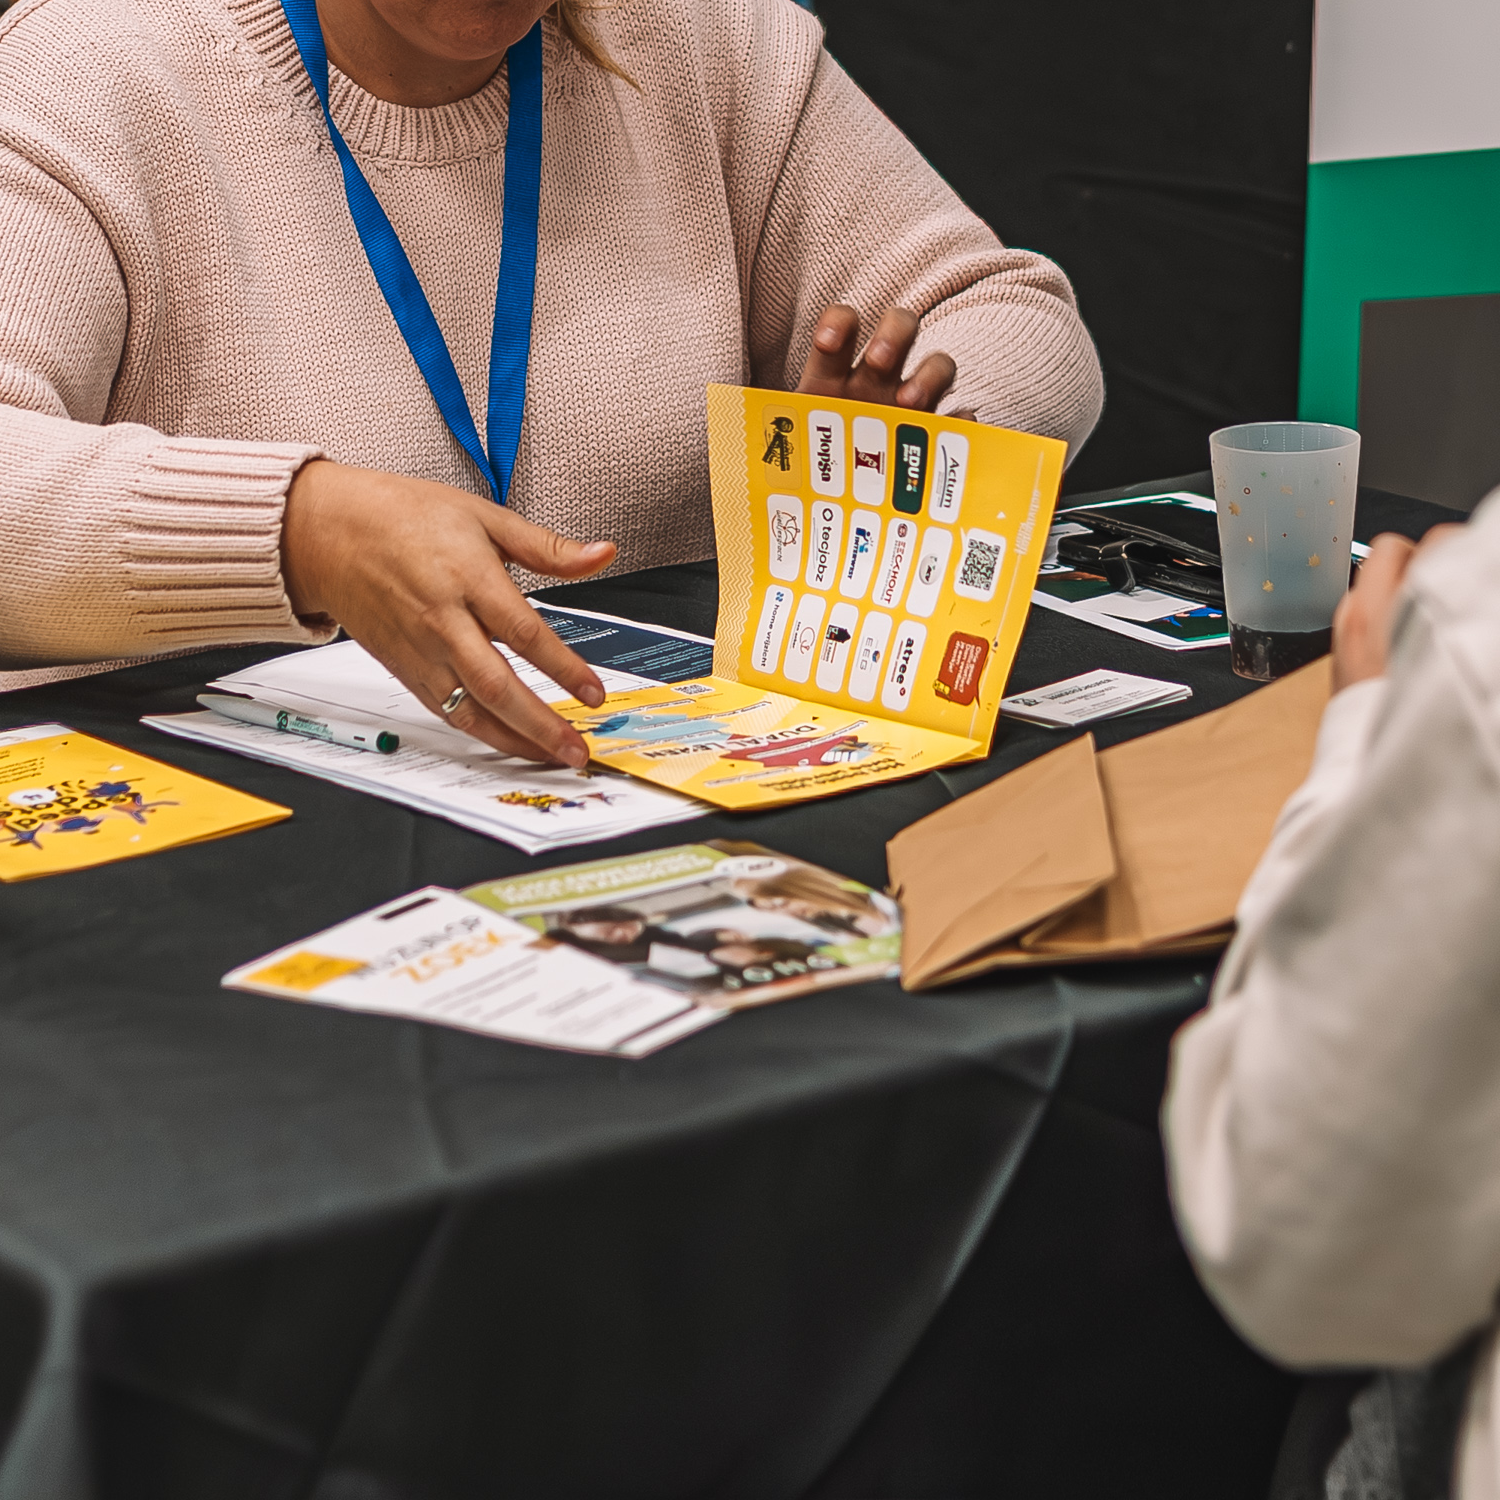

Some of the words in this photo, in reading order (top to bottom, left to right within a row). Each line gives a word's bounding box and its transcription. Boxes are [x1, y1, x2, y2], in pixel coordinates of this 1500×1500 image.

[816, 424, 834, 483] Plopsa
[907, 445, 921, 479] EDU
[943, 456, 960, 509] Actum
[815, 526, 833, 583] tecjobz
[847, 536, 860, 580] INTERWEST
[884, 540, 907, 605] EECKHOUT
[768, 603, 781, 630] home
[760, 629, 773, 667] vrijzicht
[896, 637, 915, 685] atree
[13, 793, 130, 830] speed
